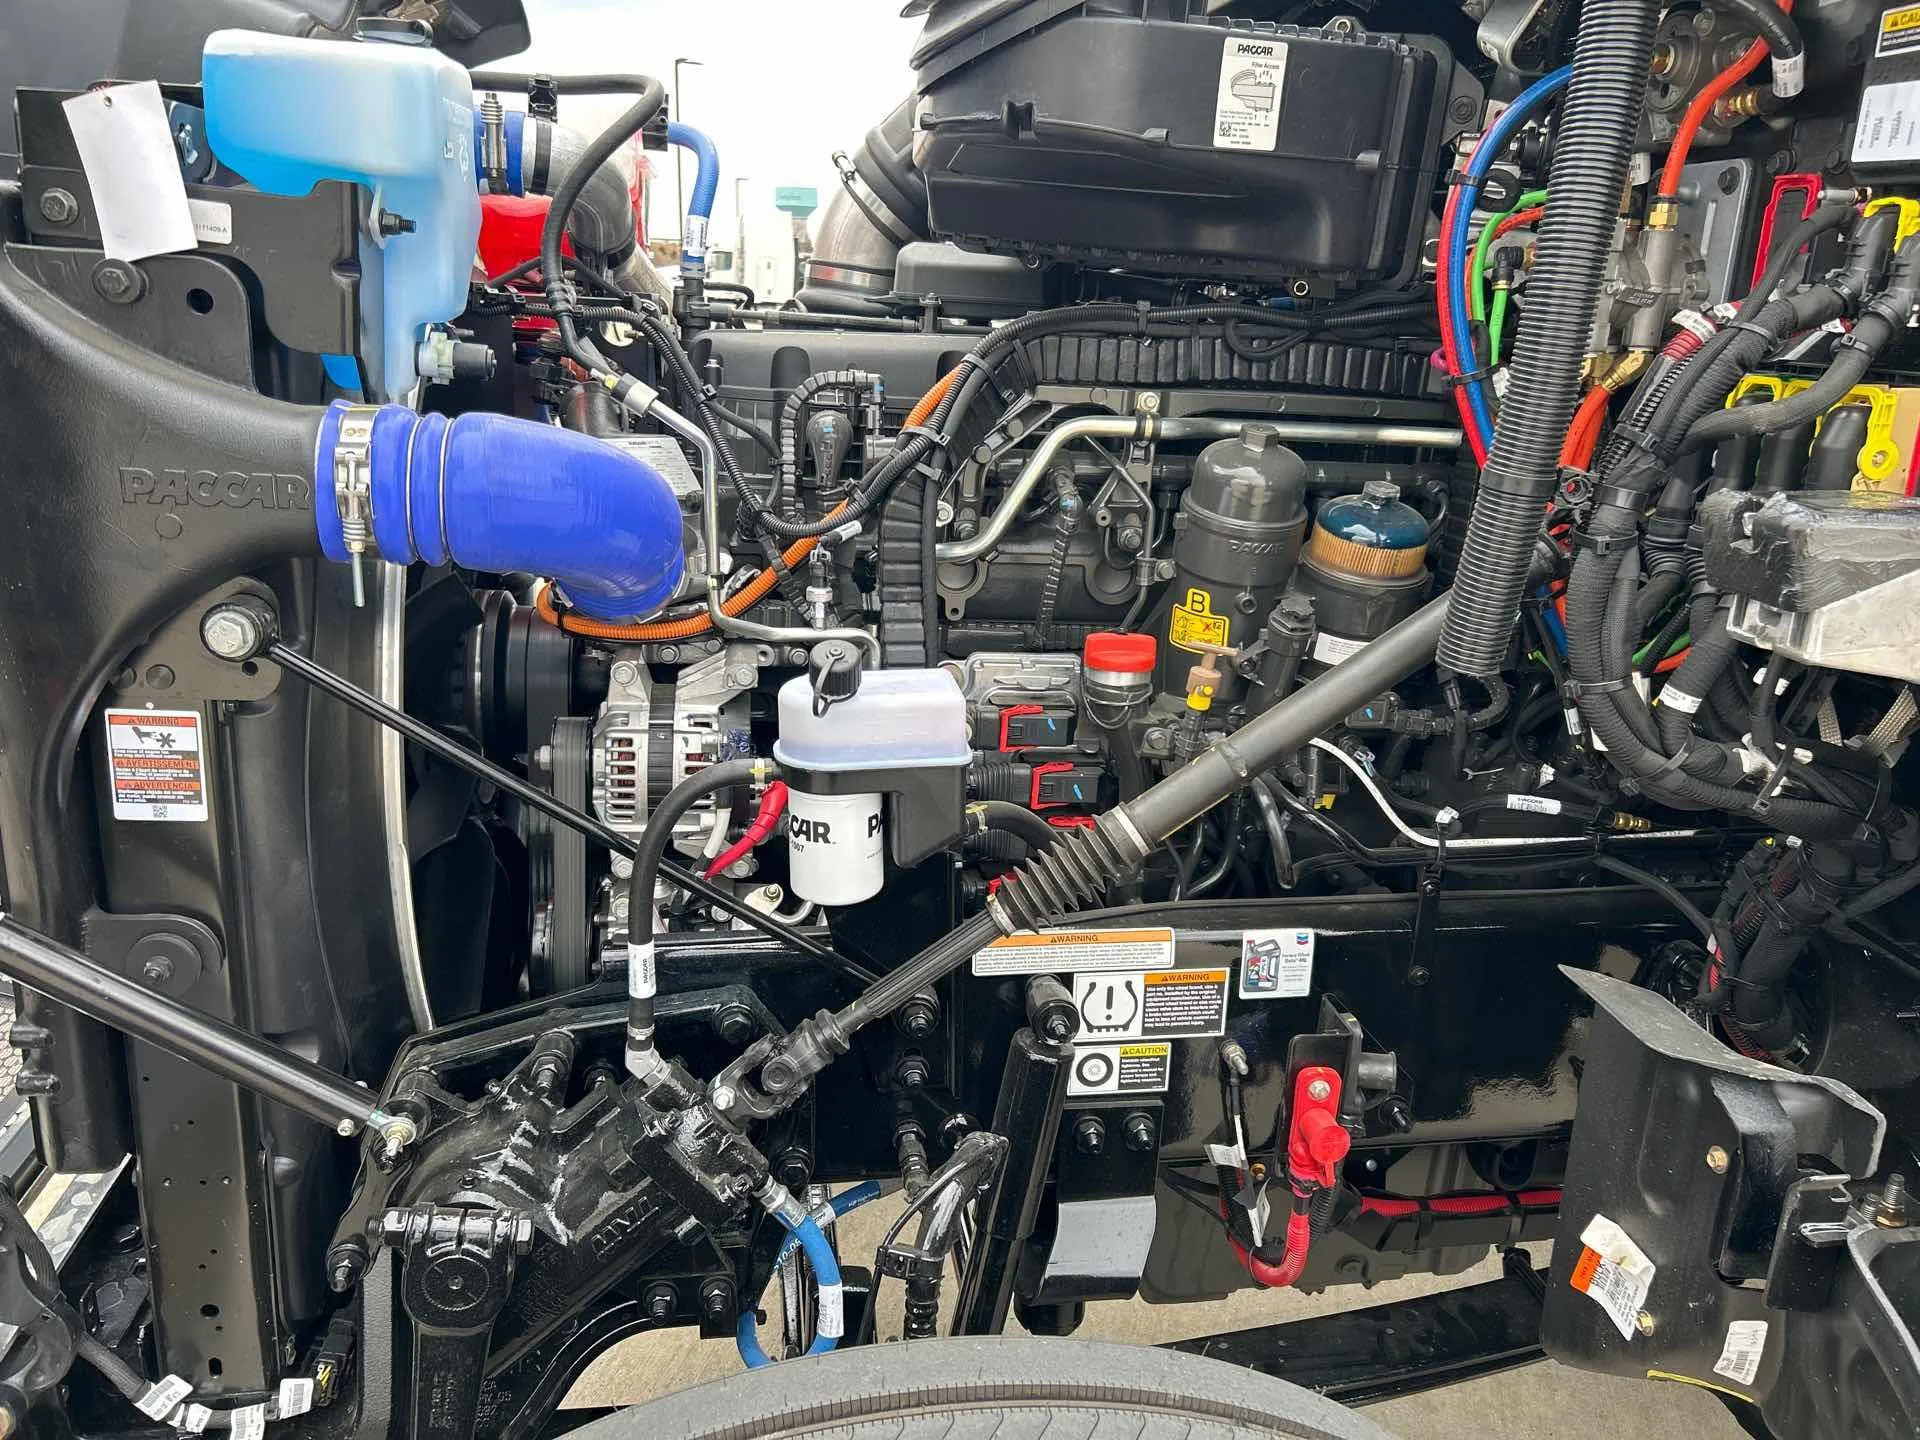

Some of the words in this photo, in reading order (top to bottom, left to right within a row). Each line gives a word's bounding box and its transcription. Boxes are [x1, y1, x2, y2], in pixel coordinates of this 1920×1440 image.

[1237, 44, 1273, 56] PACCAR
[119, 467, 311, 510] PACCAR
[1191, 592, 1205, 613] B
[137, 716, 180, 725] WARNING
[789, 814, 831, 844] CAR
[1057, 935, 1099, 943] WARNING
[1169, 973, 1210, 982] WARNING
[1129, 1046, 1168, 1055] CAUTION
